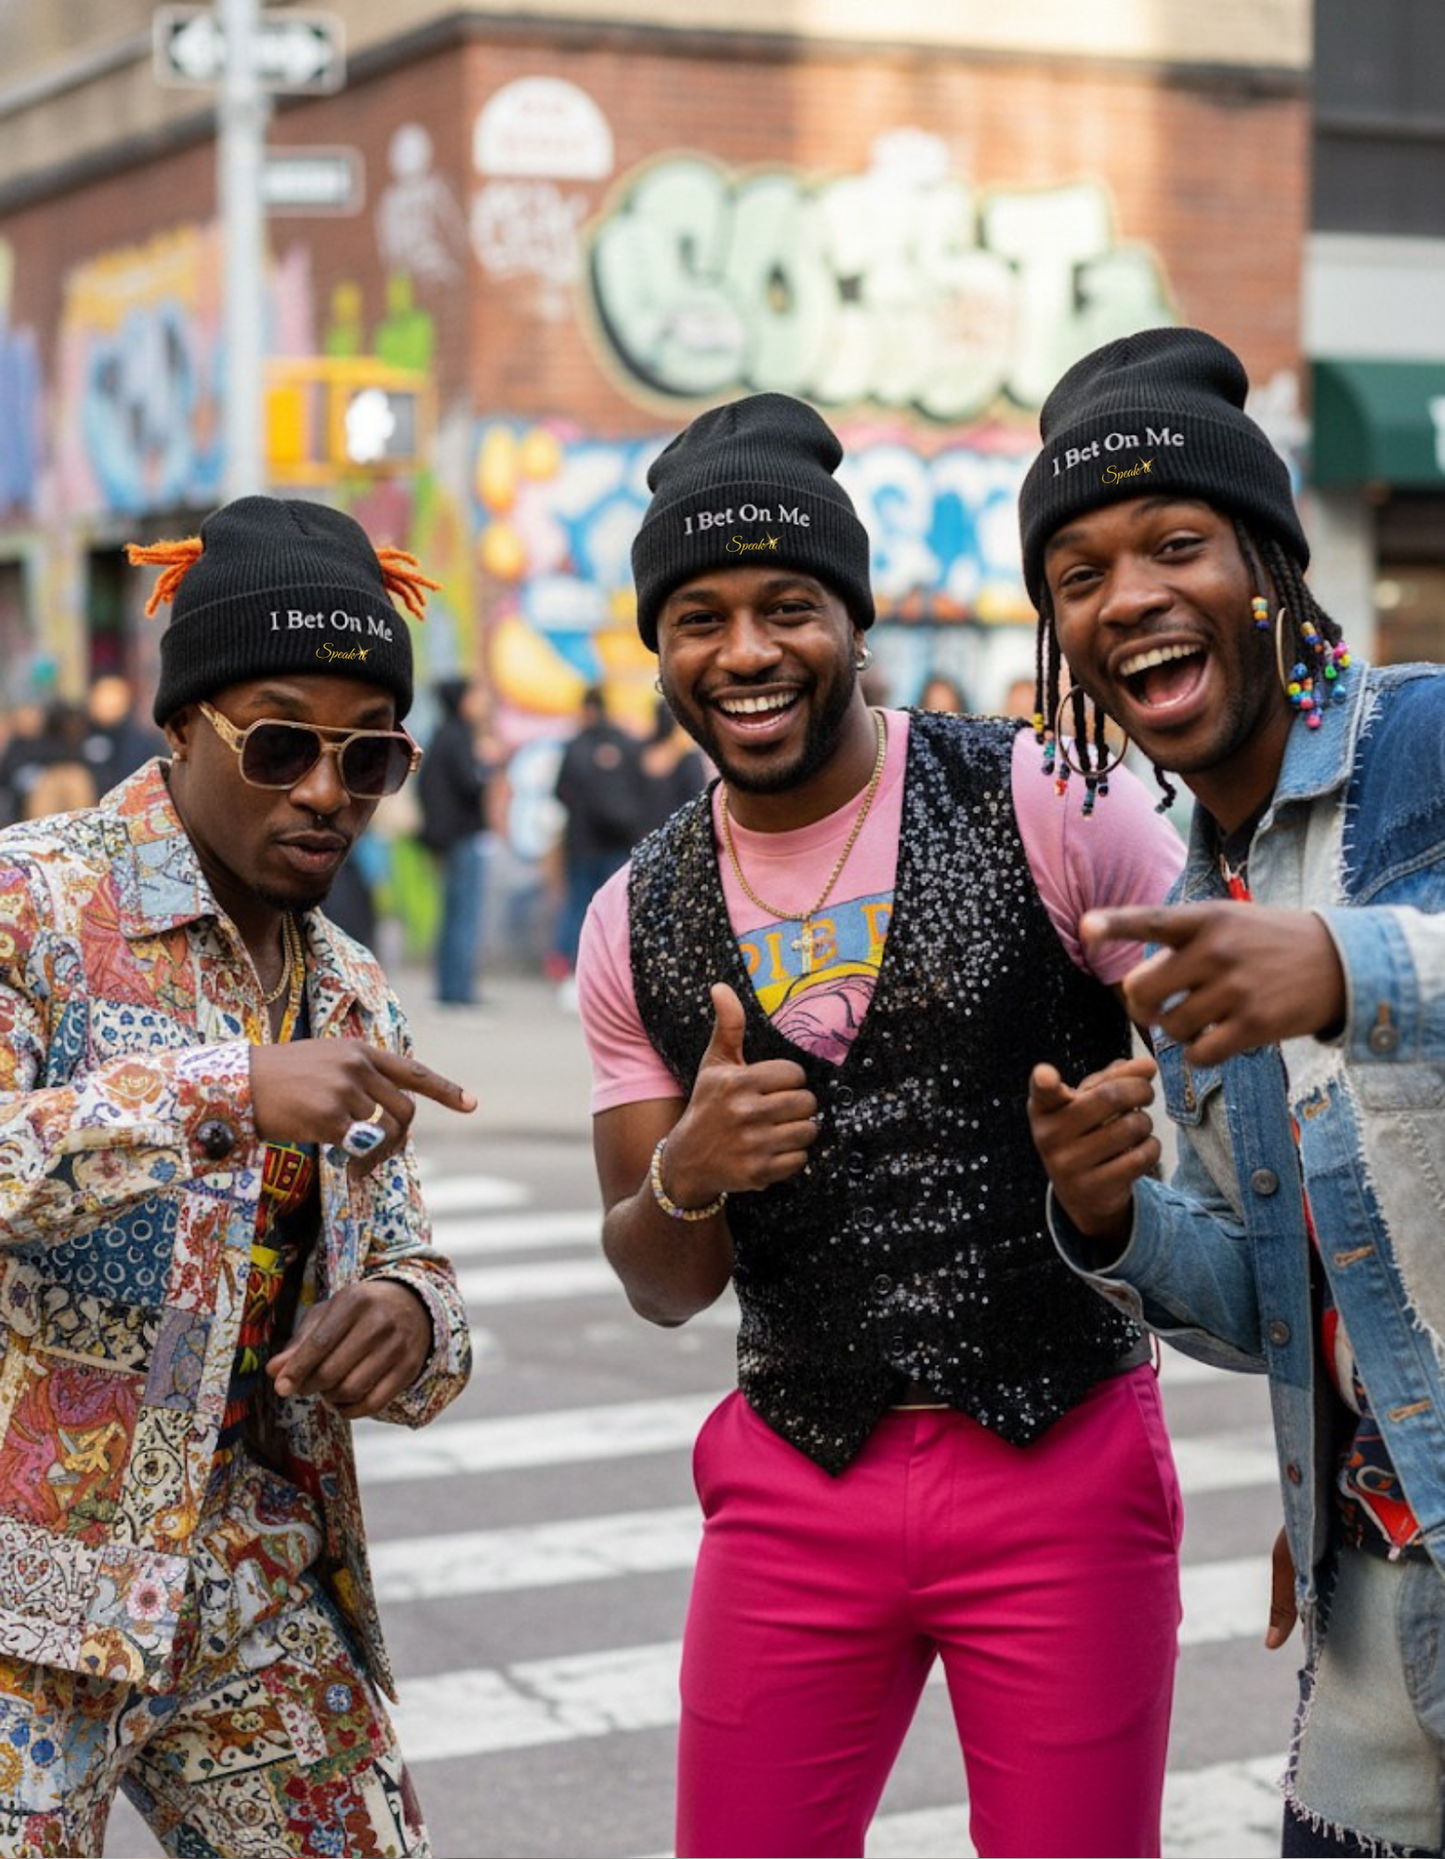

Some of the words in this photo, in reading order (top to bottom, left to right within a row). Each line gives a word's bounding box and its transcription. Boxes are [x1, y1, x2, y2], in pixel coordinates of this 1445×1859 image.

[1052, 457, 1061, 477] I
[1064, 440, 1100, 470] Bet
[1104, 432, 1140, 451] On
[1145, 427, 1185, 447] Me
[684, 516, 693, 535] I
[697, 507, 734, 531] Bet
[739, 503, 773, 522] On
[778, 503, 810, 527] Me
[270, 611, 280, 631] I
[287, 610, 325, 629] Bet
[330, 610, 362, 633] On
[367, 615, 393, 642] Me
